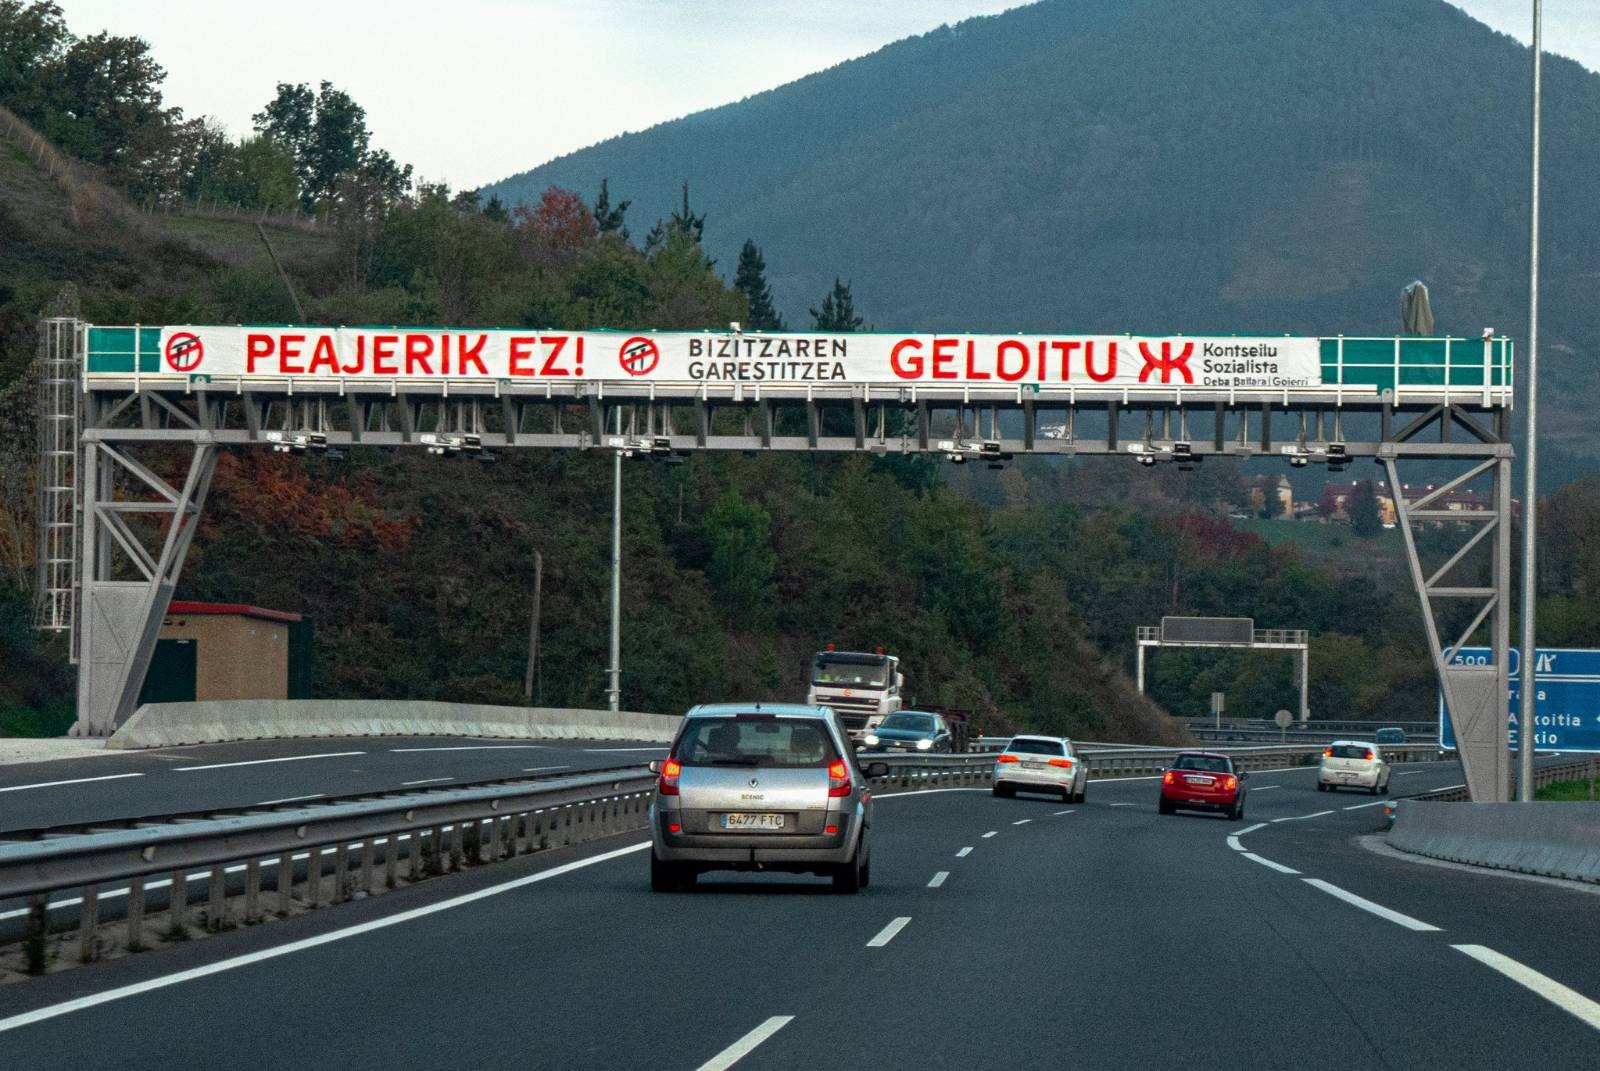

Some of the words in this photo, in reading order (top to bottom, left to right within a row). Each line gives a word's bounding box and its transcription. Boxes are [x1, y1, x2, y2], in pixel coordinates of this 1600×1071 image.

[247, 334, 489, 375] PEAJERIK
[509, 336, 584, 376] EZ!
[689, 338, 848, 358] BIZITZAREN
[1203, 342, 1278, 357] Kontseilu
[891, 339, 1118, 383] GELOITU
[1203, 359, 1278, 373] Sozialista
[688, 361, 847, 381] GARESTITZEA
[1203, 376, 1230, 386] Deba
[1454, 656, 1487, 666] 500
[1508, 712, 1581, 726] Akoitia
[1508, 730, 1558, 744] Ekio
[729, 815, 757, 825] 6477
[761, 815, 782, 826] FTC
